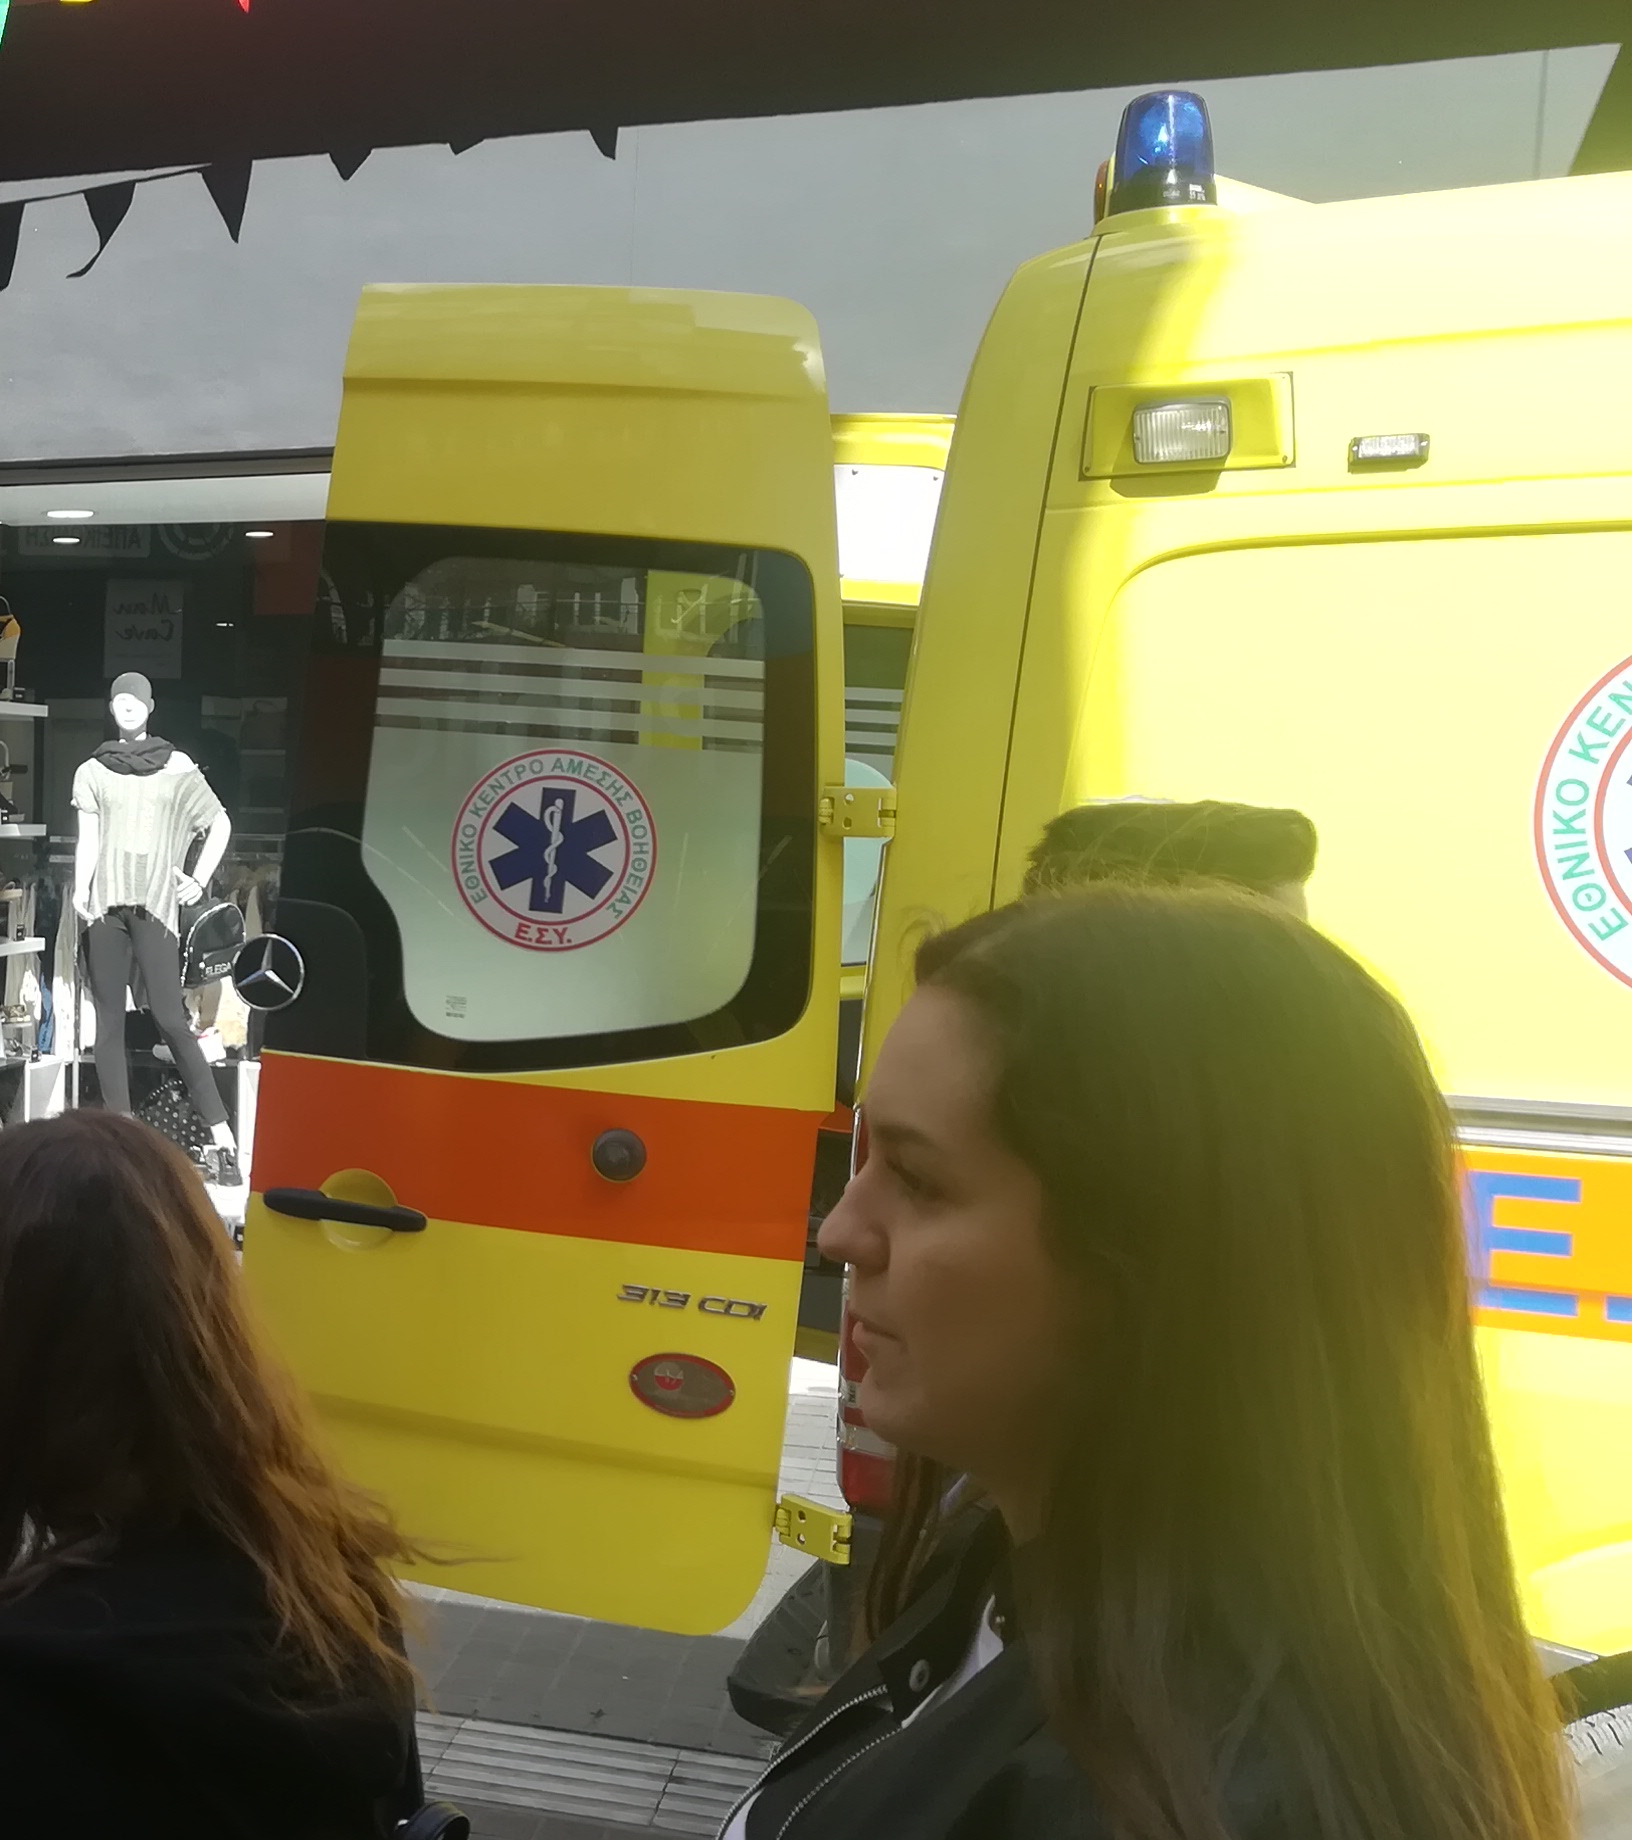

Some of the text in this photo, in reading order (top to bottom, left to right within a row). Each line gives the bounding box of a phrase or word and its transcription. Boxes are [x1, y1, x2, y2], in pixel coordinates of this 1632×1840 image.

[459, 757, 650, 920] ΕΘΝΙΚΟ ΚΕΝΤΡΟ ΑΜΕΣΗΣ ΒΟΗΘΕΙΑΣ
[1552, 778, 1629, 941] ΕΘΝΙΚΟ
[616, 1284, 767, 1321] 313 CDI
